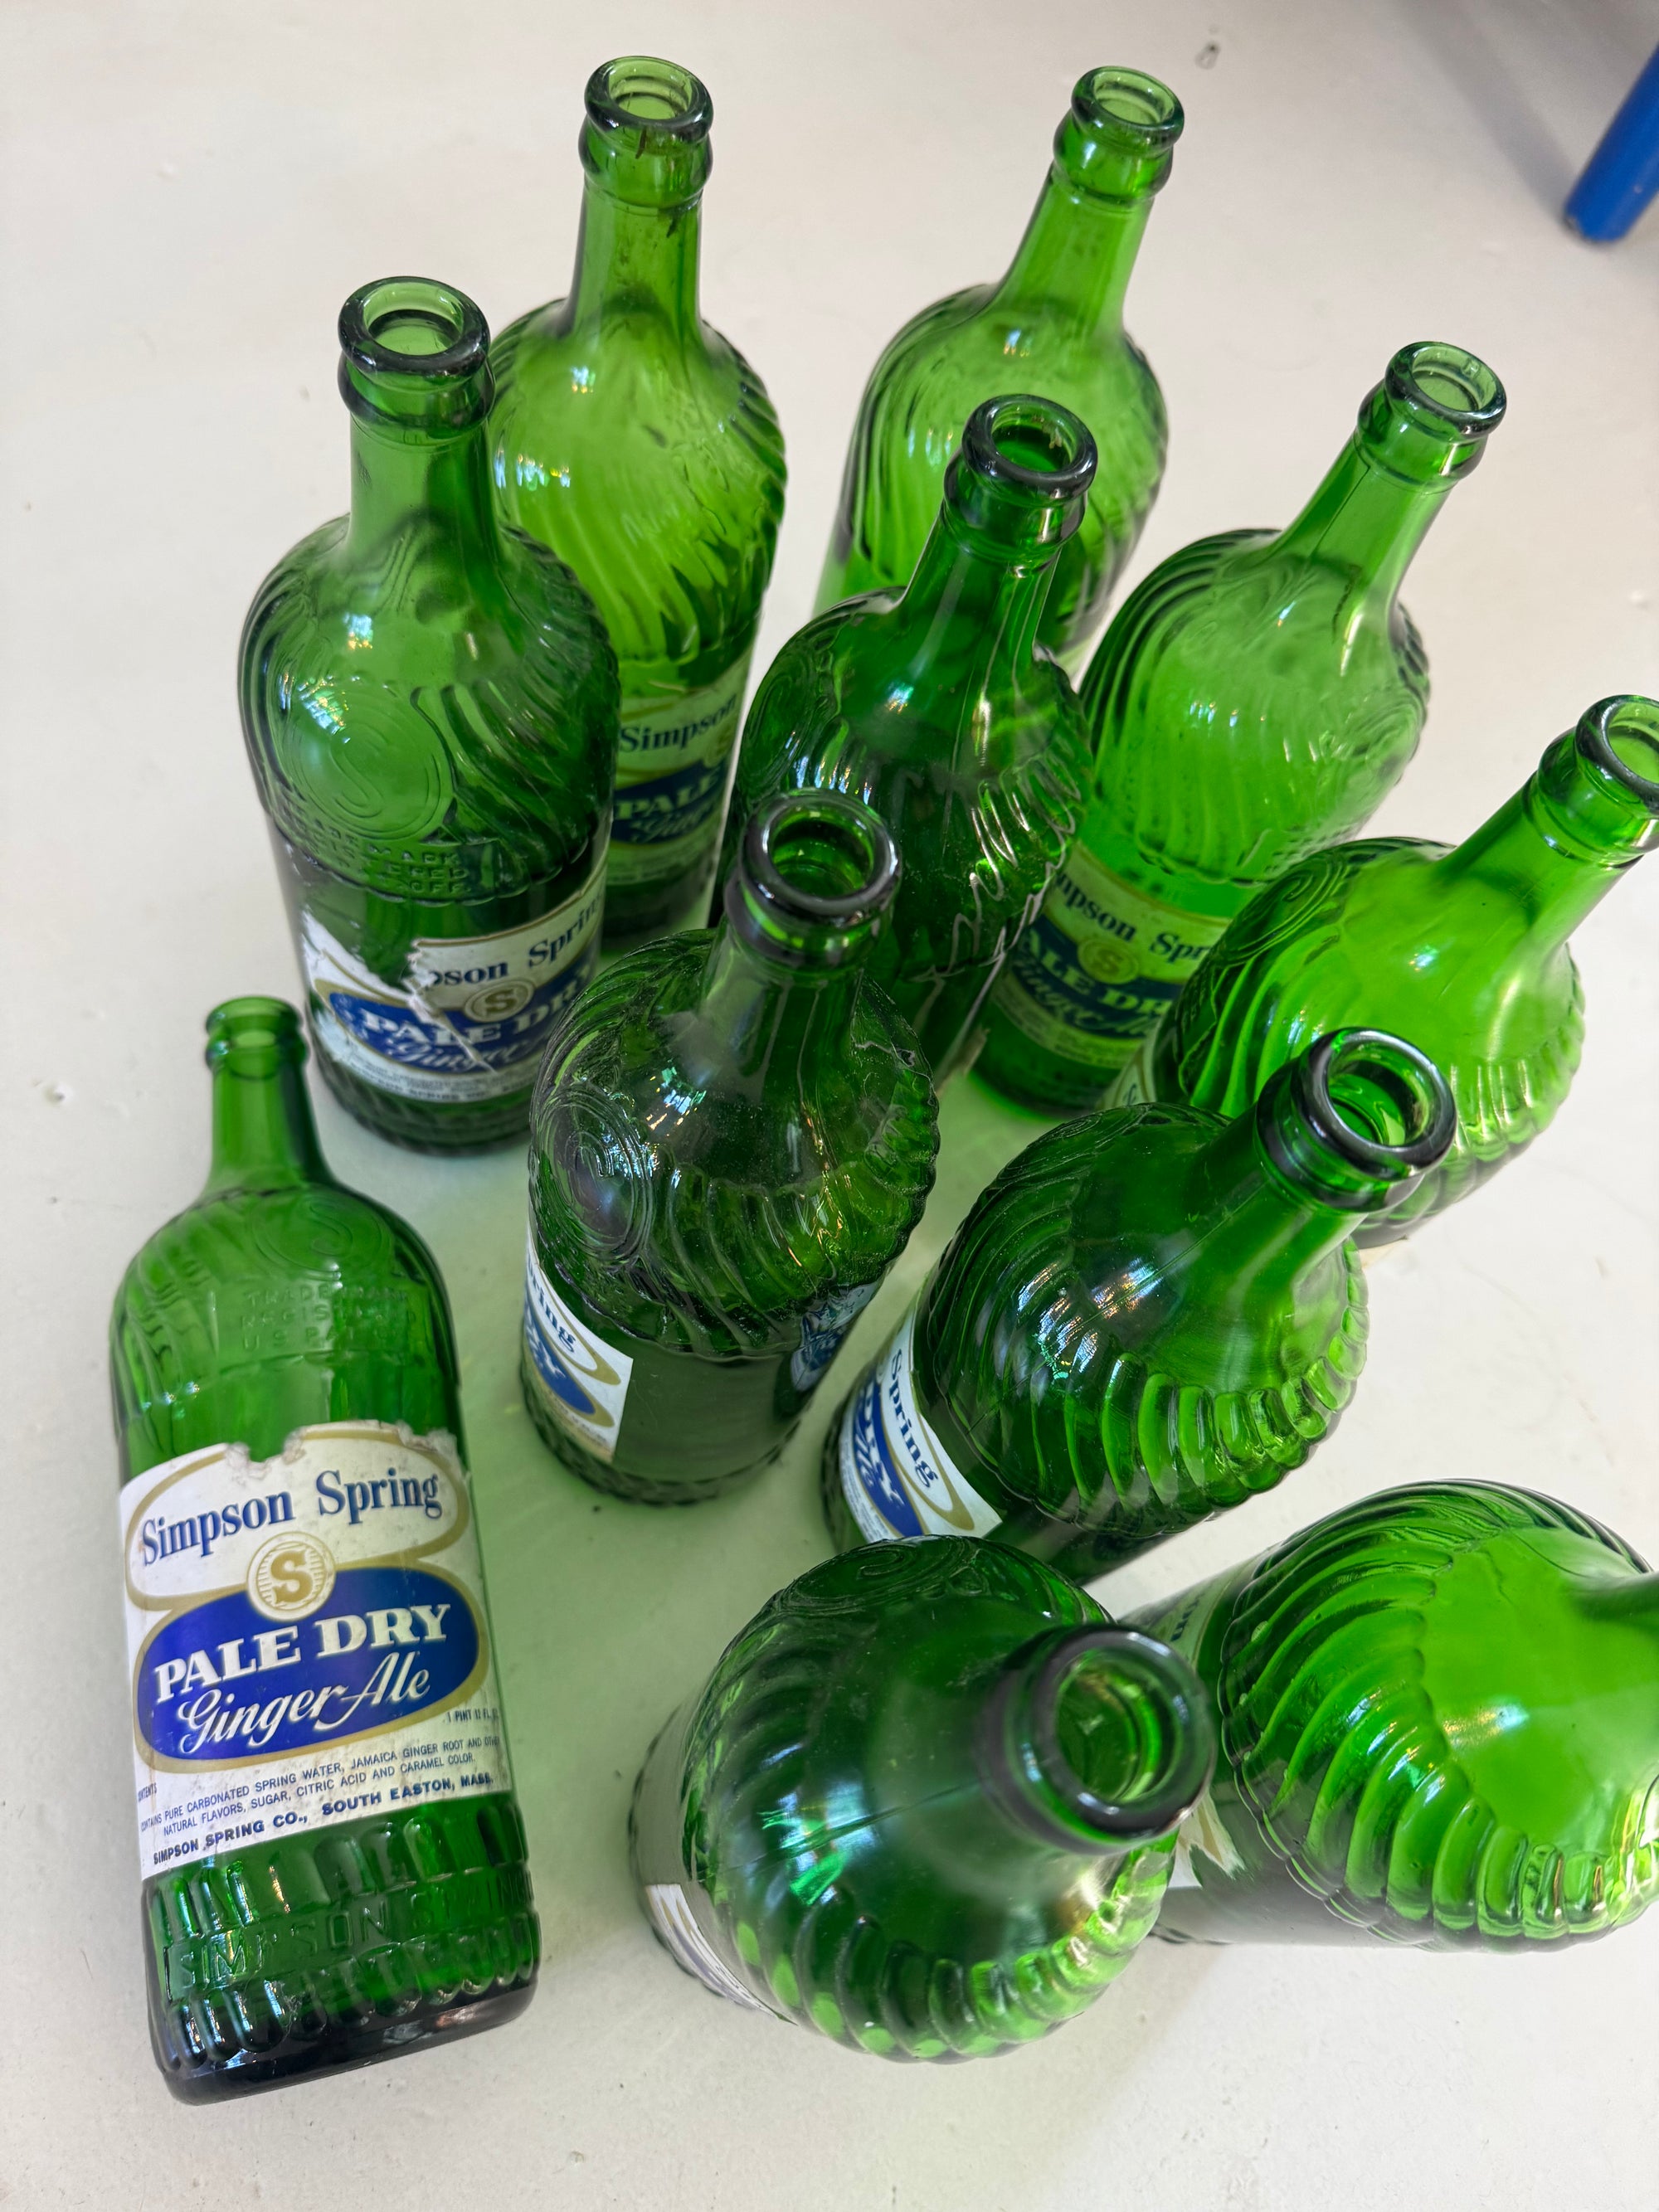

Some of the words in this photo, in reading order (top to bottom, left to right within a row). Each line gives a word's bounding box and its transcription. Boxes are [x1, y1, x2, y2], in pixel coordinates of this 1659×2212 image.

[1055, 872, 1136, 942] mpson
[1149, 931, 1211, 964] Spr
[889, 1348, 939, 1490] Spring
[142, 1490, 294, 1566] Simpson
[315, 1467, 444, 1525] Spring
[270, 1551, 314, 1606] S
[153, 1624, 301, 1704] PALE
[314, 1602, 452, 1659] DRY
[177, 1684, 349, 1754] Ginger
[314, 1650, 431, 1730] Ale
[455, 1709, 472, 1723] PINT
[140, 1813, 163, 1832] CONTAINS
[164, 1805, 183, 1821] PURE
[187, 1785, 250, 1813] CARBONATED
[255, 1773, 296, 1791] SPRING
[302, 1762, 345, 1780] WATER,
[351, 1751, 397, 1770] JAMAICA
[402, 1743, 439, 1758] GINGER
[443, 1739, 465, 1753] ROOT
[468, 1738, 482, 1748] AND
[153, 1838, 199, 1865] SIMPSON
[205, 1819, 265, 1848] SPRING
[273, 1811, 308, 1828] CO.,
[322, 1791, 382, 1816] SOUTH
[390, 1777, 455, 1801] EASTON,
[460, 1772, 494, 1788] MASS.
[163, 1816, 198, 1836] NATURAL
[202, 1802, 246, 1824] FLAVORS,
[251, 1790, 291, 1809] SUGAR,
[296, 1779, 334, 1797] CITRIC
[340, 1772, 367, 1787] ACID
[372, 1766, 395, 1780] AND
[400, 1757, 444, 1774] CARAMEL
[448, 1752, 476, 1766] COLOR.
